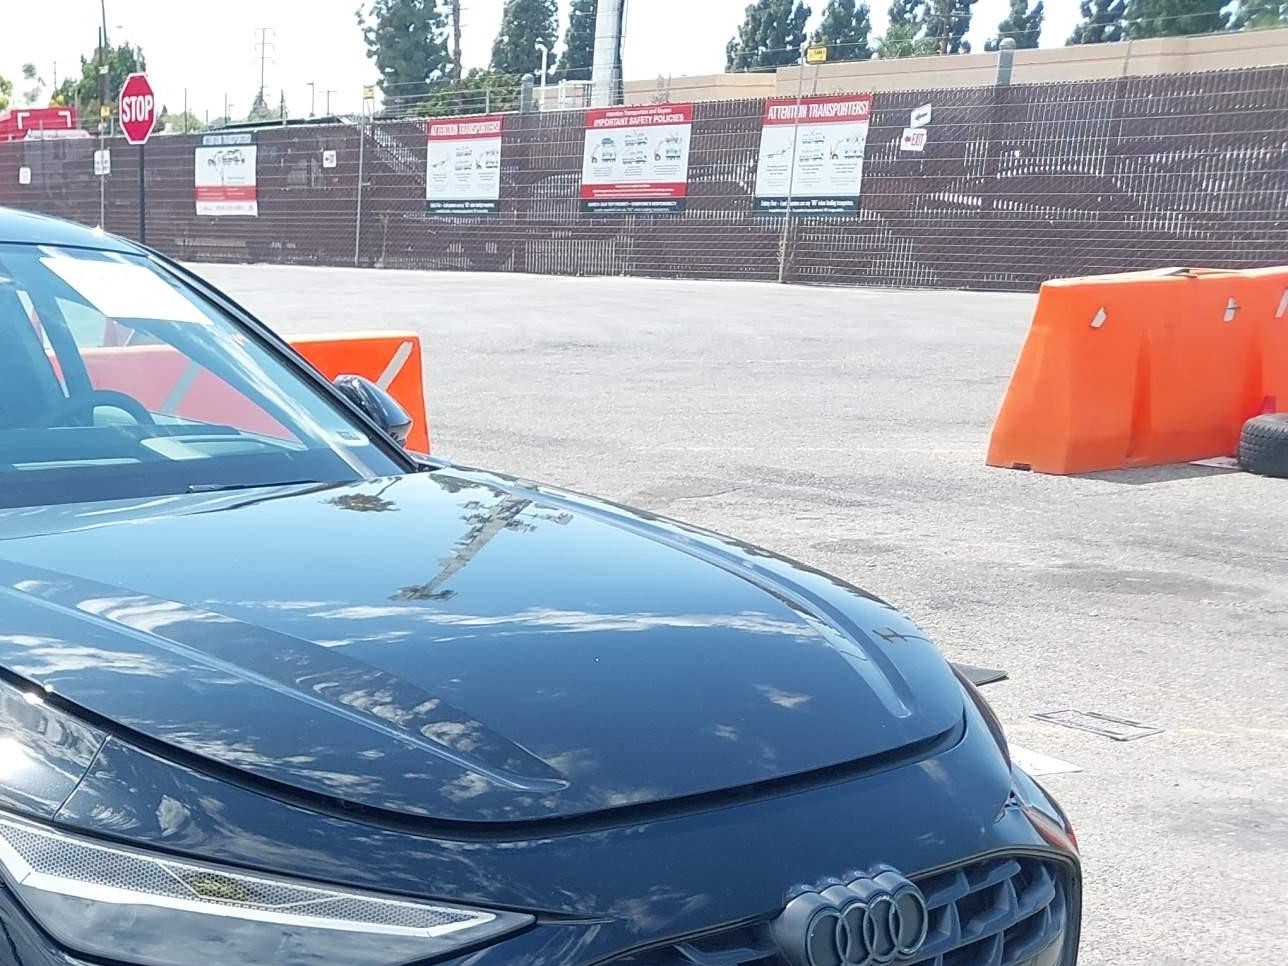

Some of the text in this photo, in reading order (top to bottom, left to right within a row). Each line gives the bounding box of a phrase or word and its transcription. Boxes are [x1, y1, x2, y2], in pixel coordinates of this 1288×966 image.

[122, 94, 153, 123] STOP
[809, 101, 869, 118] TRANSPORTERS!
[593, 113, 684, 127] IMPORTANT SAFETY POLICIES
[911, 132, 924, 147] EXIT
